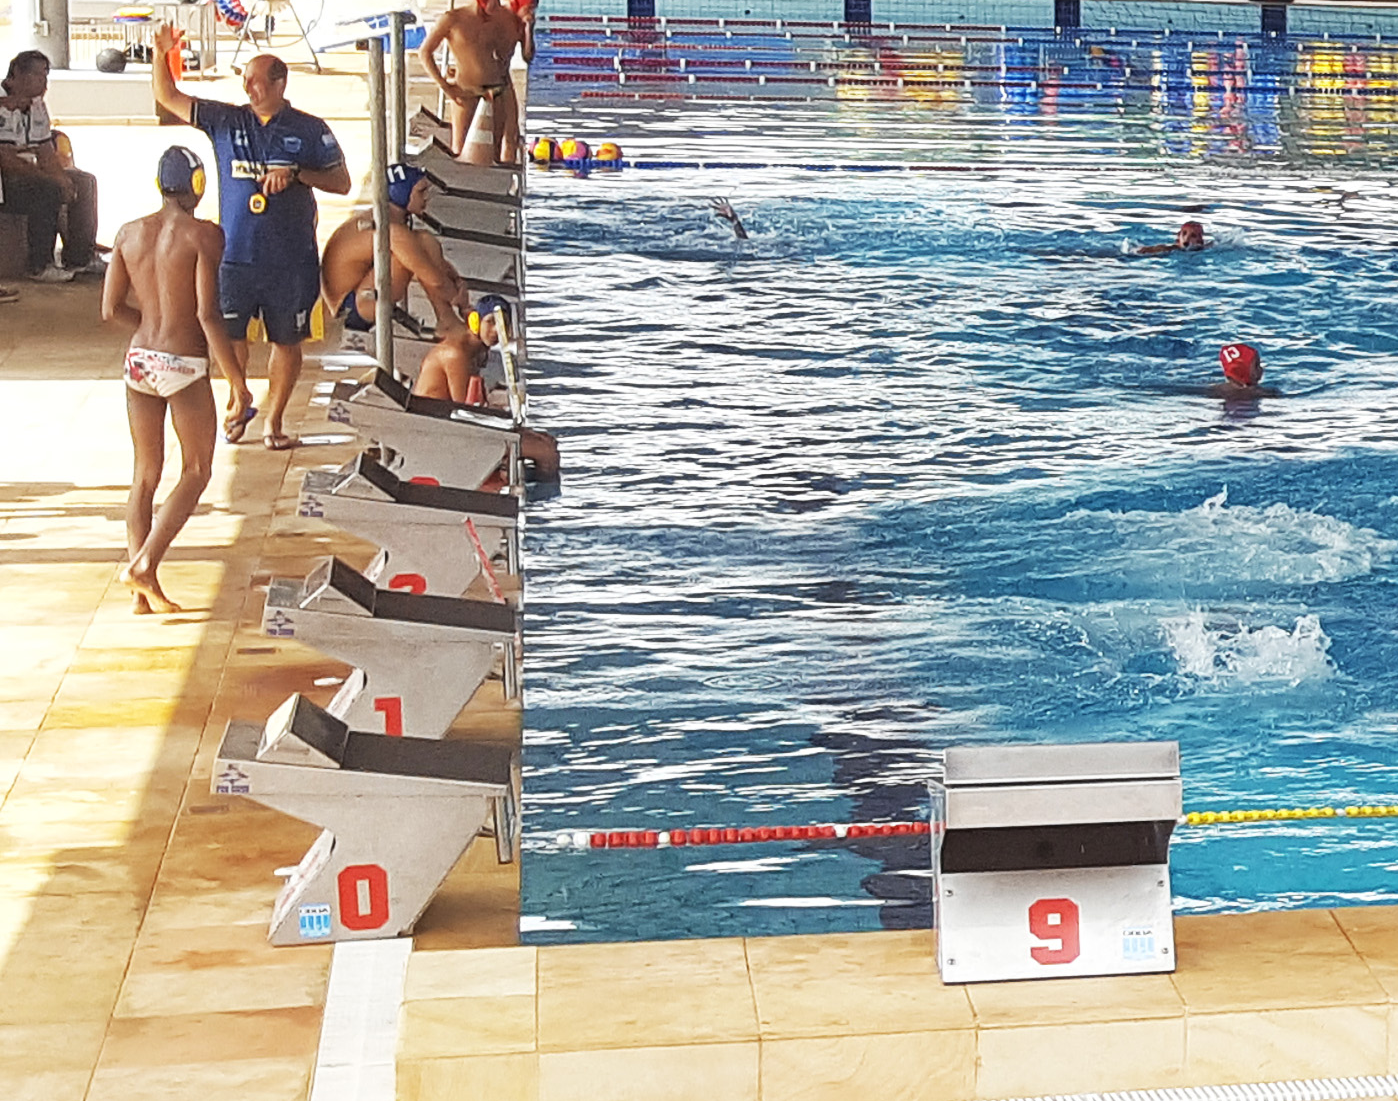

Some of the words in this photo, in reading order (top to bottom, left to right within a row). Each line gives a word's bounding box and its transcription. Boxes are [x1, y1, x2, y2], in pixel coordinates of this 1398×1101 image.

[1222, 346, 1240, 363] 13
[338, 864, 389, 930] 0
[1028, 898, 1080, 965] 9
